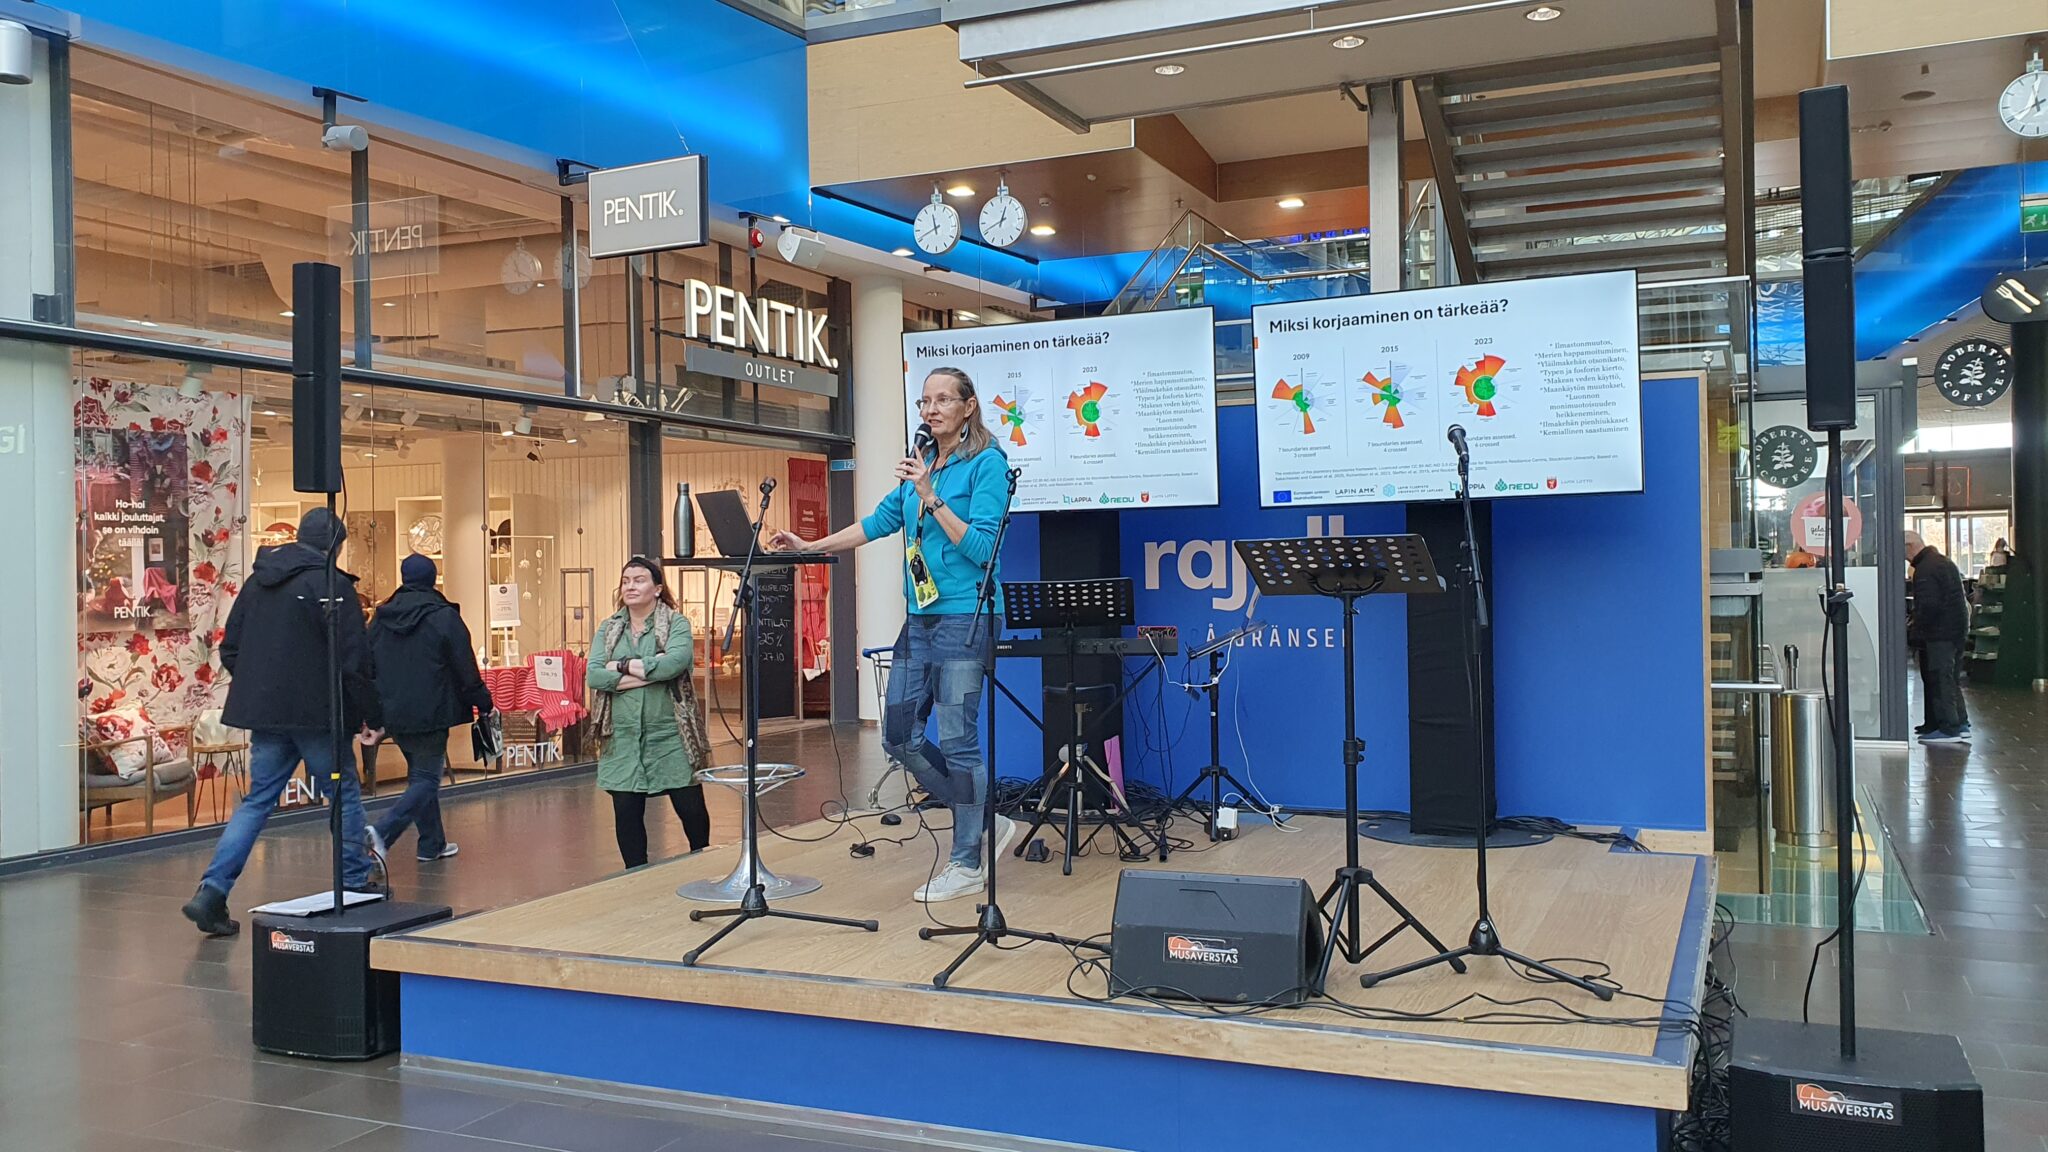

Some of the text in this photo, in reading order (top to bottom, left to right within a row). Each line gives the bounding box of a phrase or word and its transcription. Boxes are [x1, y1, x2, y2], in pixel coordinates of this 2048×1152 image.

[1269, 298, 1509, 333] Miksi korjaaminen on tärkeää?
[683, 278, 839, 369] PENTIK.
[916, 331, 1110, 358] Miksi korjaaminen on tärkeää?
[1474, 337, 1493, 346] 2023
[1380, 345, 1399, 353] 2015
[1292, 353, 1310, 361] 2009
[1941, 343, 2006, 371] ROBERT'S
[745, 362, 795, 384] OUTLET
[1007, 371, 1022, 379] 2015
[1943, 377, 2004, 402] COFFEE
[843, 461, 856, 469] 125
[1760, 456, 1812, 485] COFFEE
[115, 499, 146, 509] Ho-hoi
[94, 512, 165, 523] kaikki jouluttajat,
[102, 526, 113, 535] se
[128, 525, 159, 535] vihdoin
[761, 603, 773, 615] &
[272, 942, 315, 953] MUSAVERSTAS
[1169, 950, 1238, 964] MUSAVERSTAS
[1799, 1099, 1894, 1120] MUSAVERSTAS
